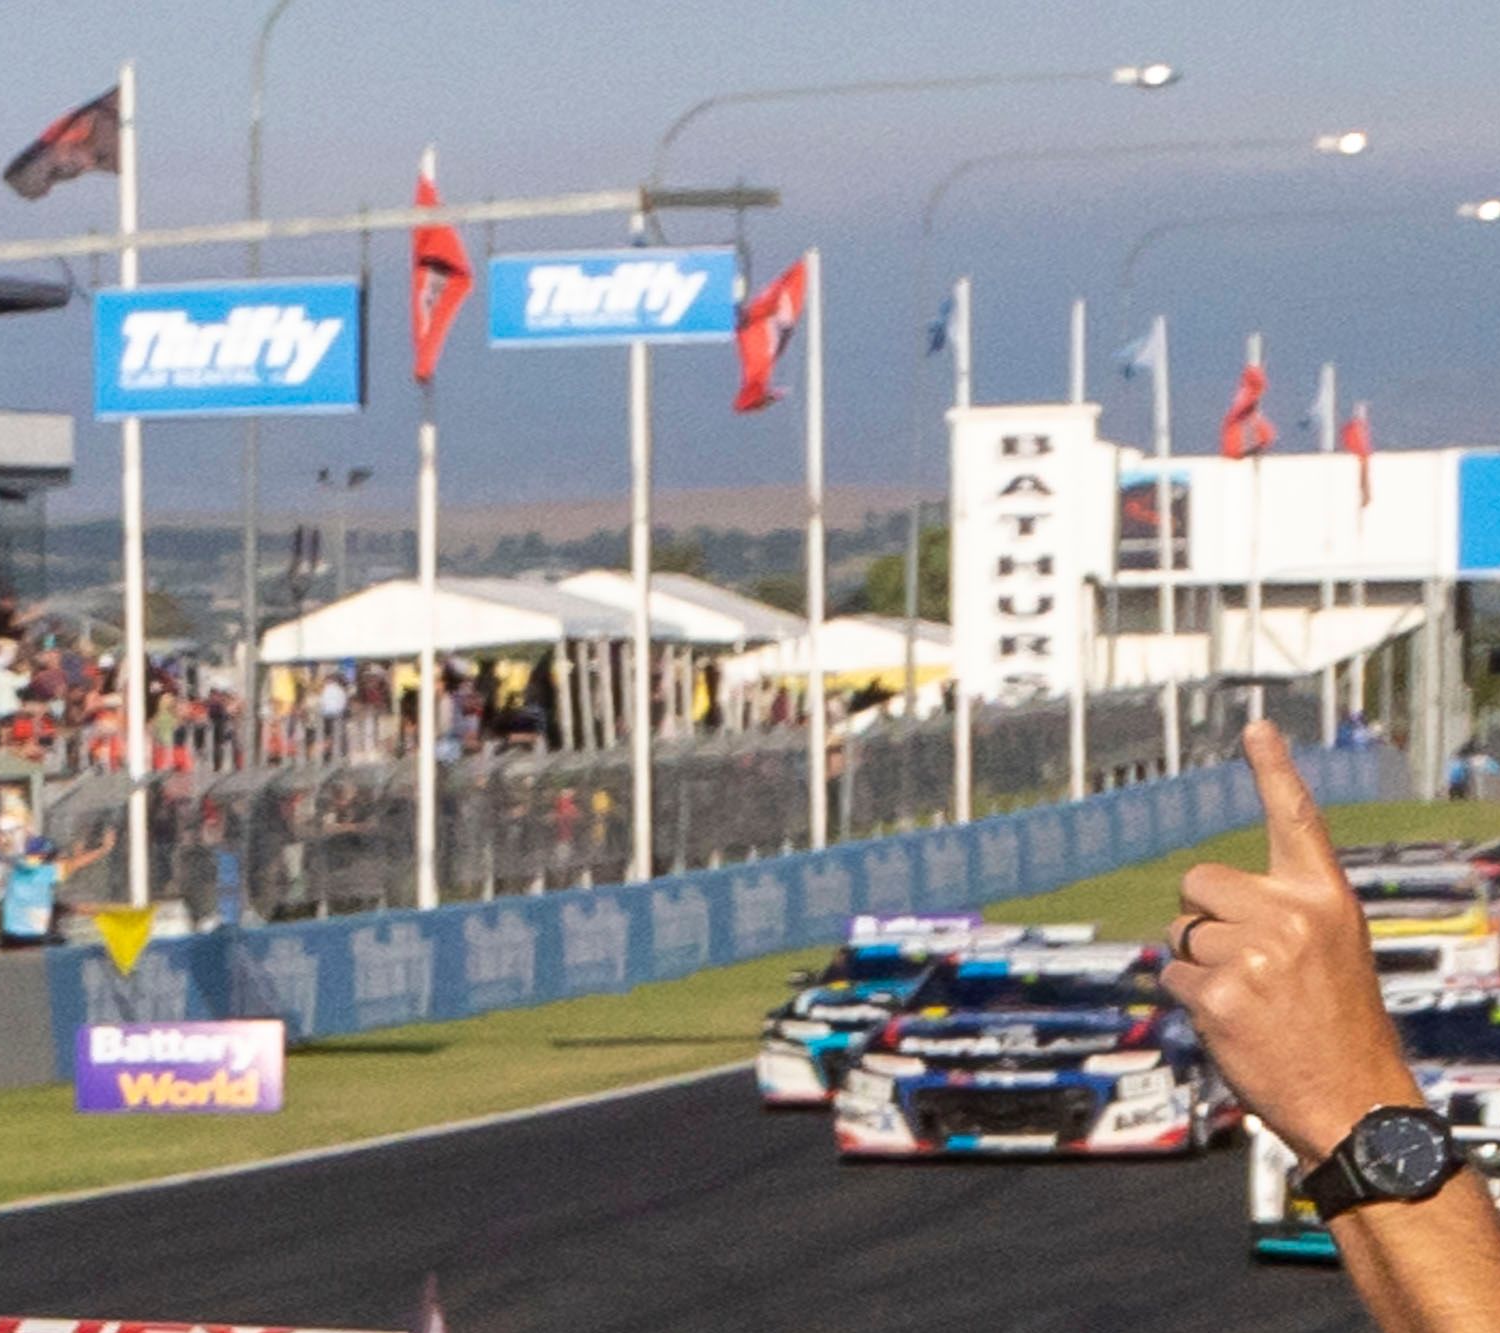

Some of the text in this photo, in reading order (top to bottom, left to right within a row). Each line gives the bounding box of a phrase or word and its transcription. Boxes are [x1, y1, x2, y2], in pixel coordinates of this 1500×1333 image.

[527, 262, 708, 326] Thrifty
[120, 305, 344, 386] Thrifty
[996, 432, 1056, 700] BATHURS
[90, 1026, 256, 1073] Battery
[117, 1070, 261, 1109] World
